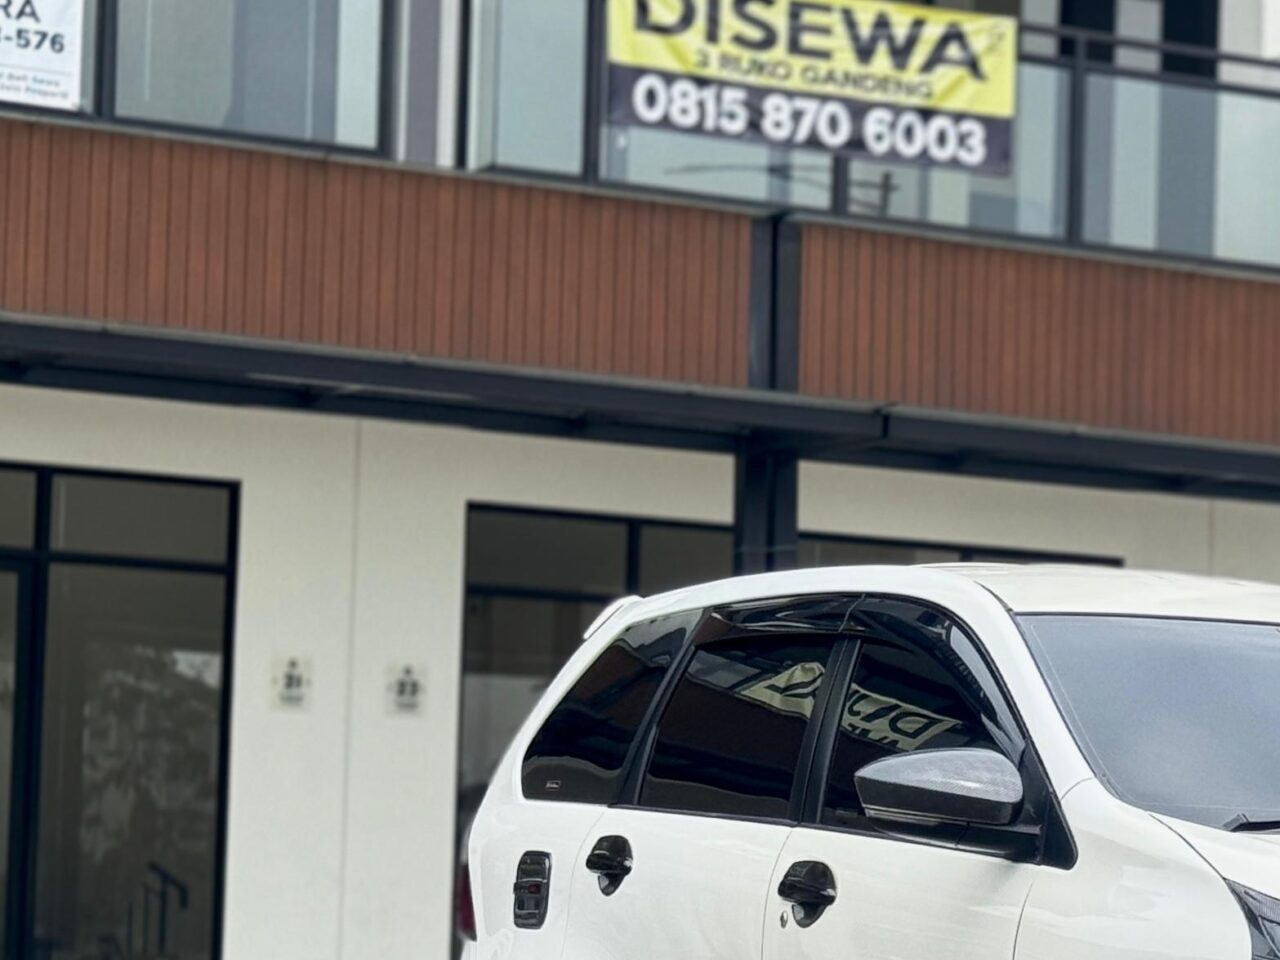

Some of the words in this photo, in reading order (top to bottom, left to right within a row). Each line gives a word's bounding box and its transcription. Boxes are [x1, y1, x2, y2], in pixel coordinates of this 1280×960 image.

[636, 0, 987, 81] DISEWA
[632, 74, 749, 135] 0815
[759, 93, 852, 149] 870
[863, 107, 986, 166] 6003
